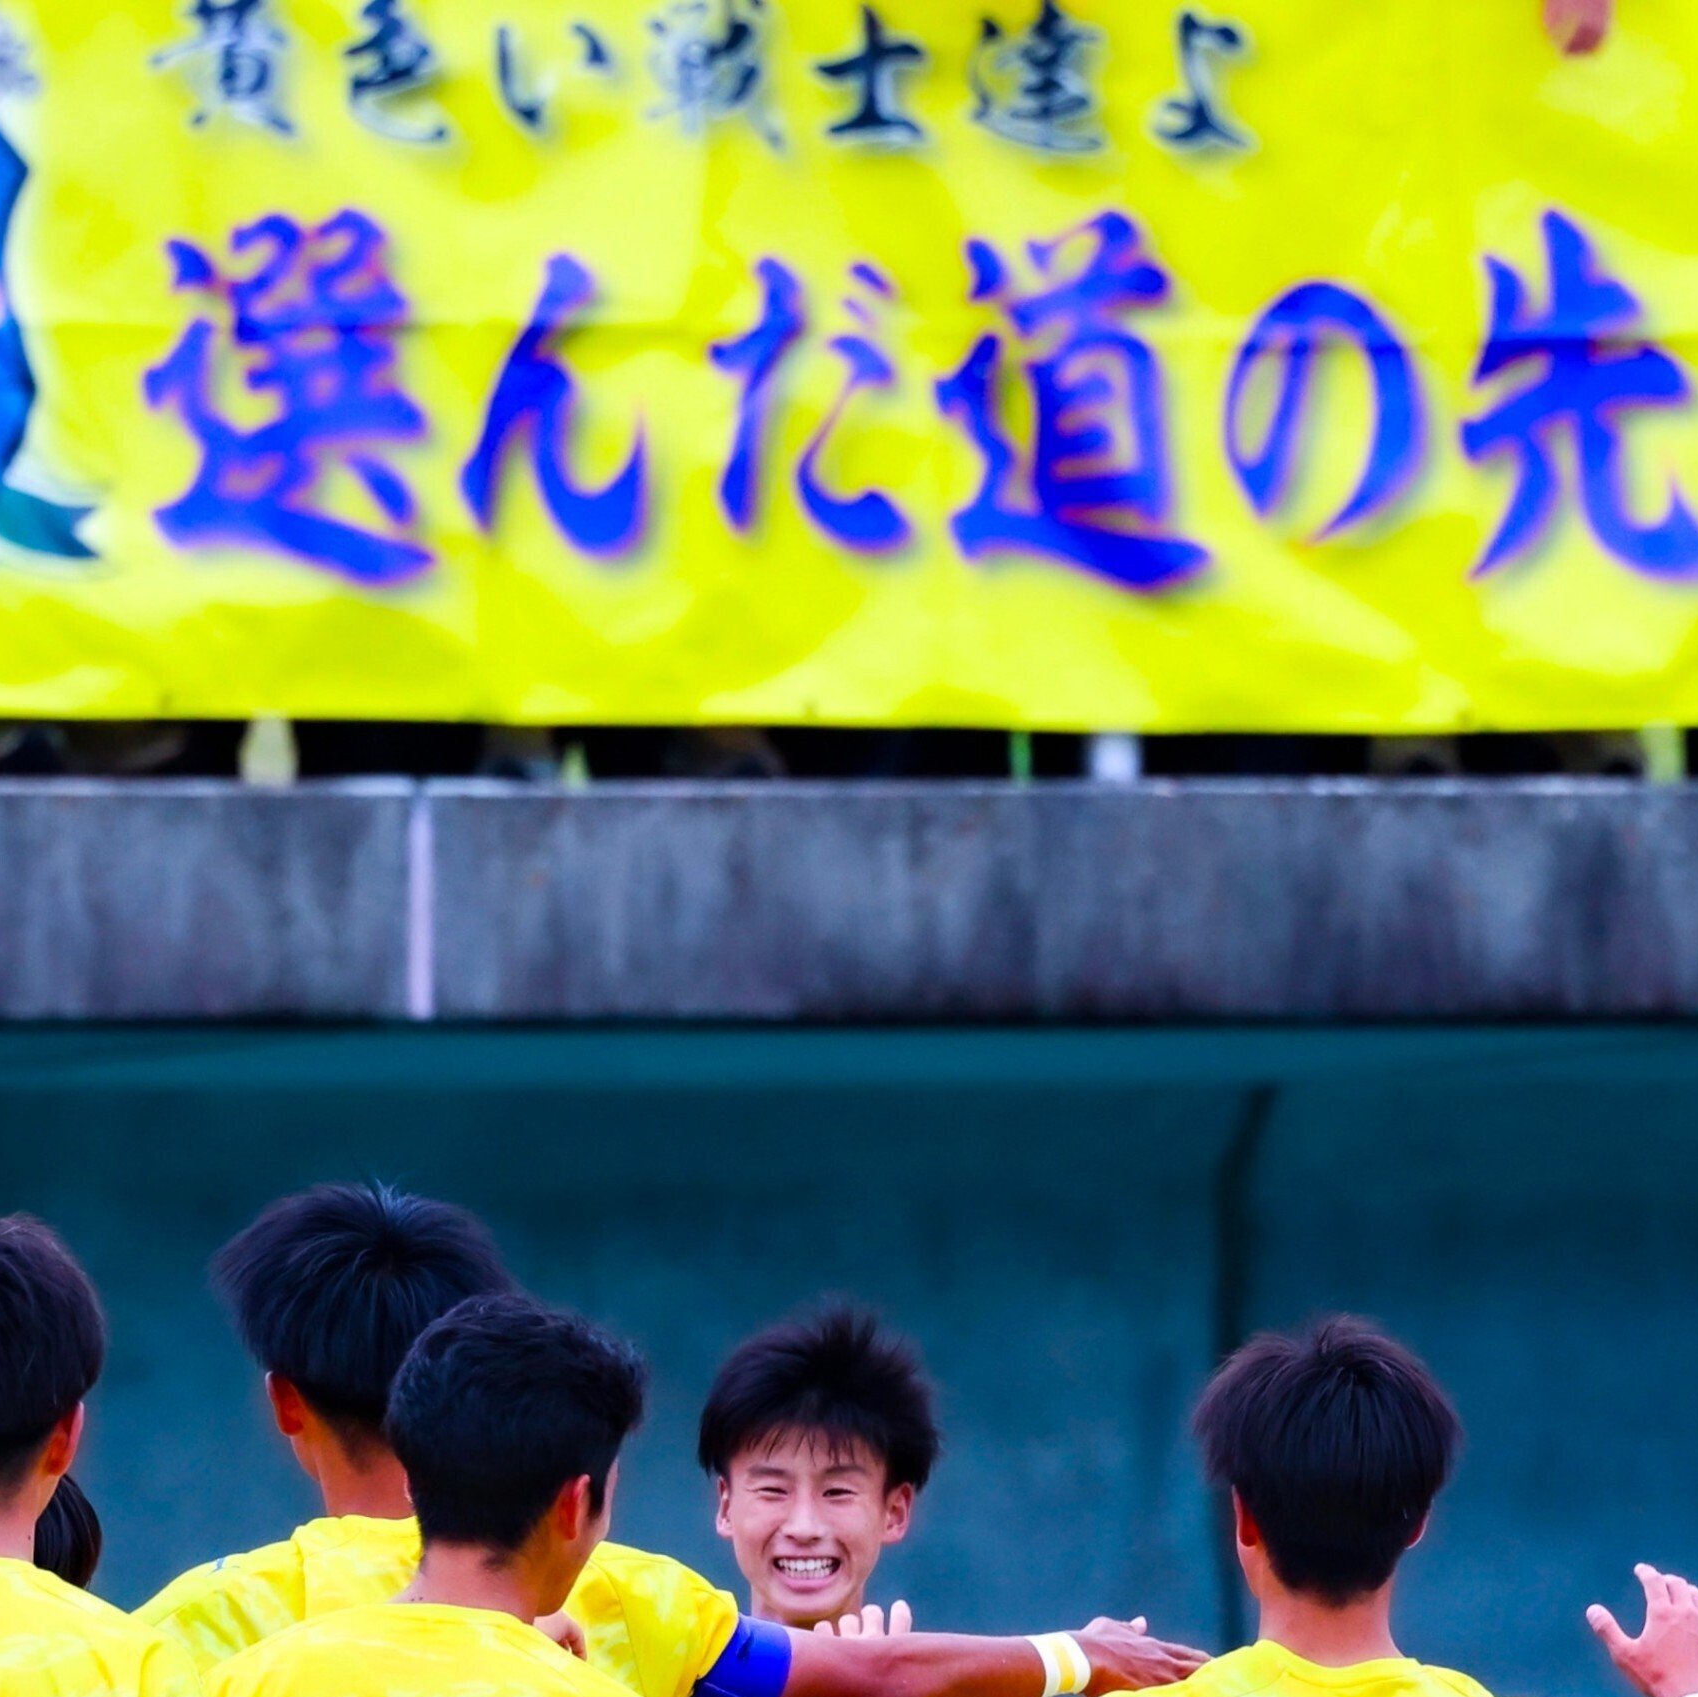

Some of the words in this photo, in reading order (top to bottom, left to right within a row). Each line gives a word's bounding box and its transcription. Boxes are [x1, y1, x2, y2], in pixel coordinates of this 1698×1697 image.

[149, 0, 1258, 150] 黄色い戦士達よ
